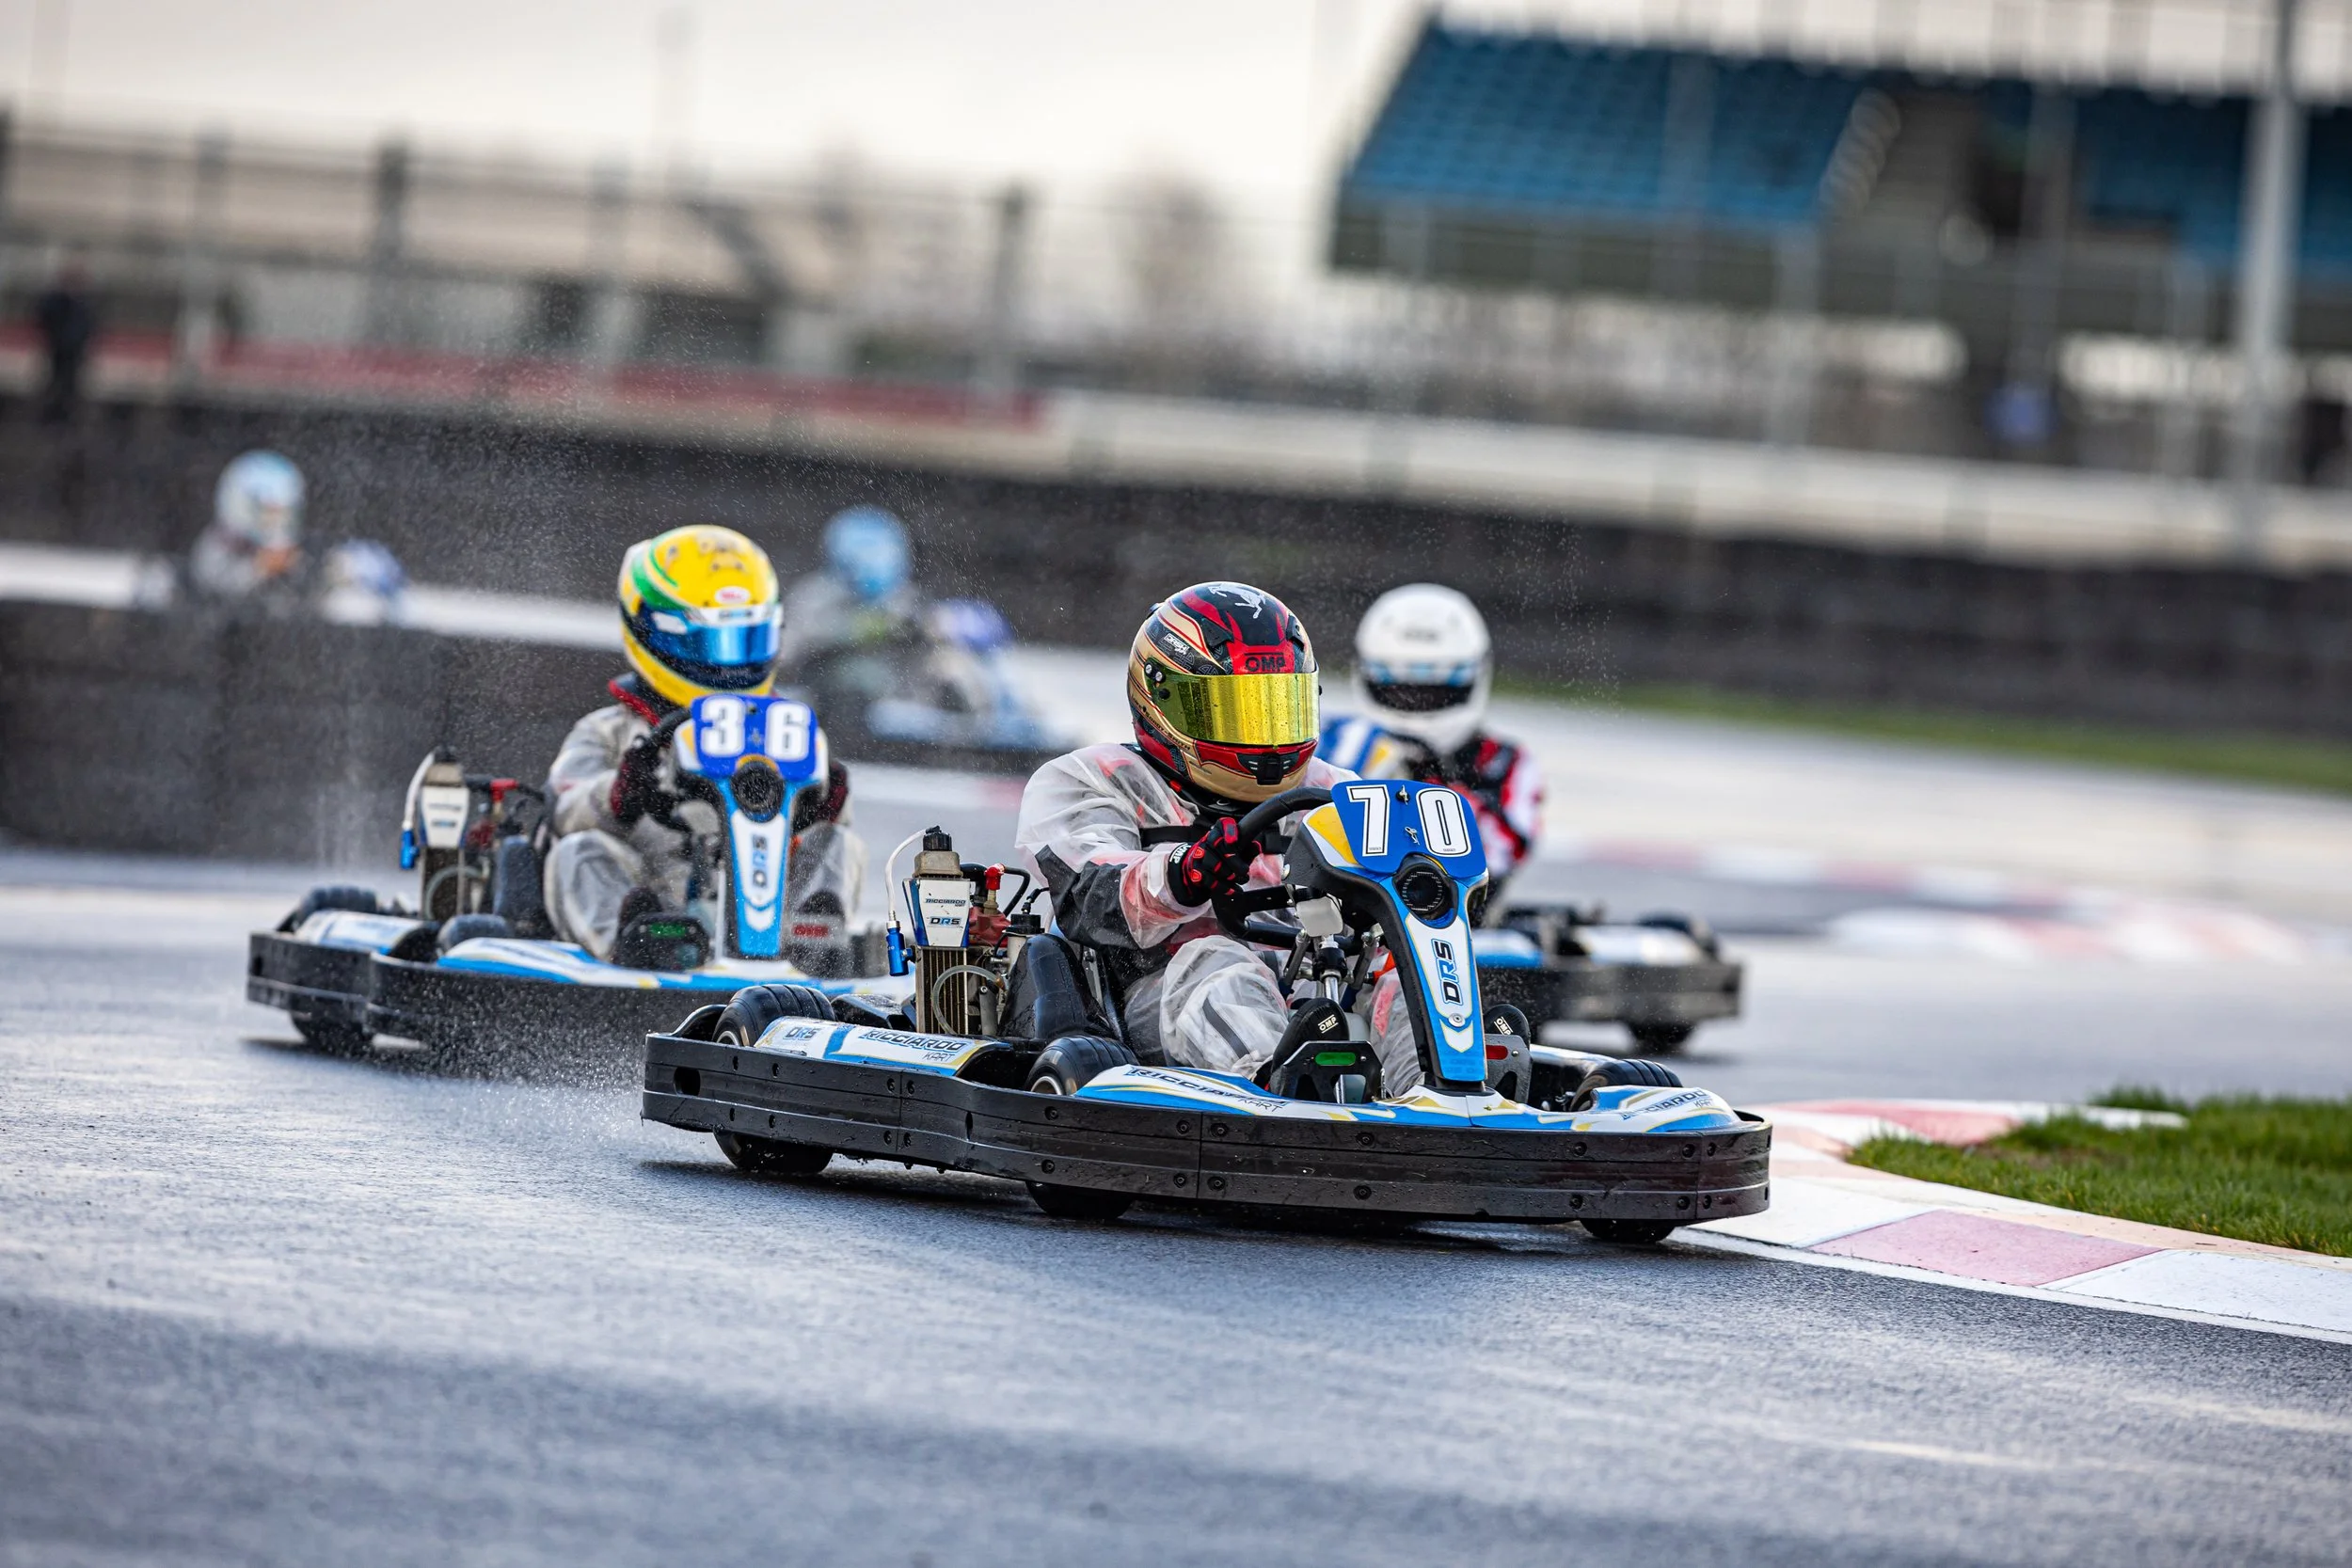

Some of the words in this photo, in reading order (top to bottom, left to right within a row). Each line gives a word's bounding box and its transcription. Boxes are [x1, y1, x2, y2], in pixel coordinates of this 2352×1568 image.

[1245, 656, 1286, 672] OMP
[700, 696, 811, 761] 36
[1345, 784, 1472, 857] 70
[930, 917, 961, 926] DRS
[1433, 939, 1463, 1006] DRS
[785, 1026, 820, 1040] DRS
[1319, 1017, 1337, 1031] OMP
[1496, 1018, 1511, 1035] OMP
[863, 1029, 967, 1052] RICCIARDO
[924, 1052, 956, 1063] KART
[1125, 1066, 1288, 1106] RICCIA
[1621, 1087, 1708, 1120] CIARDO
